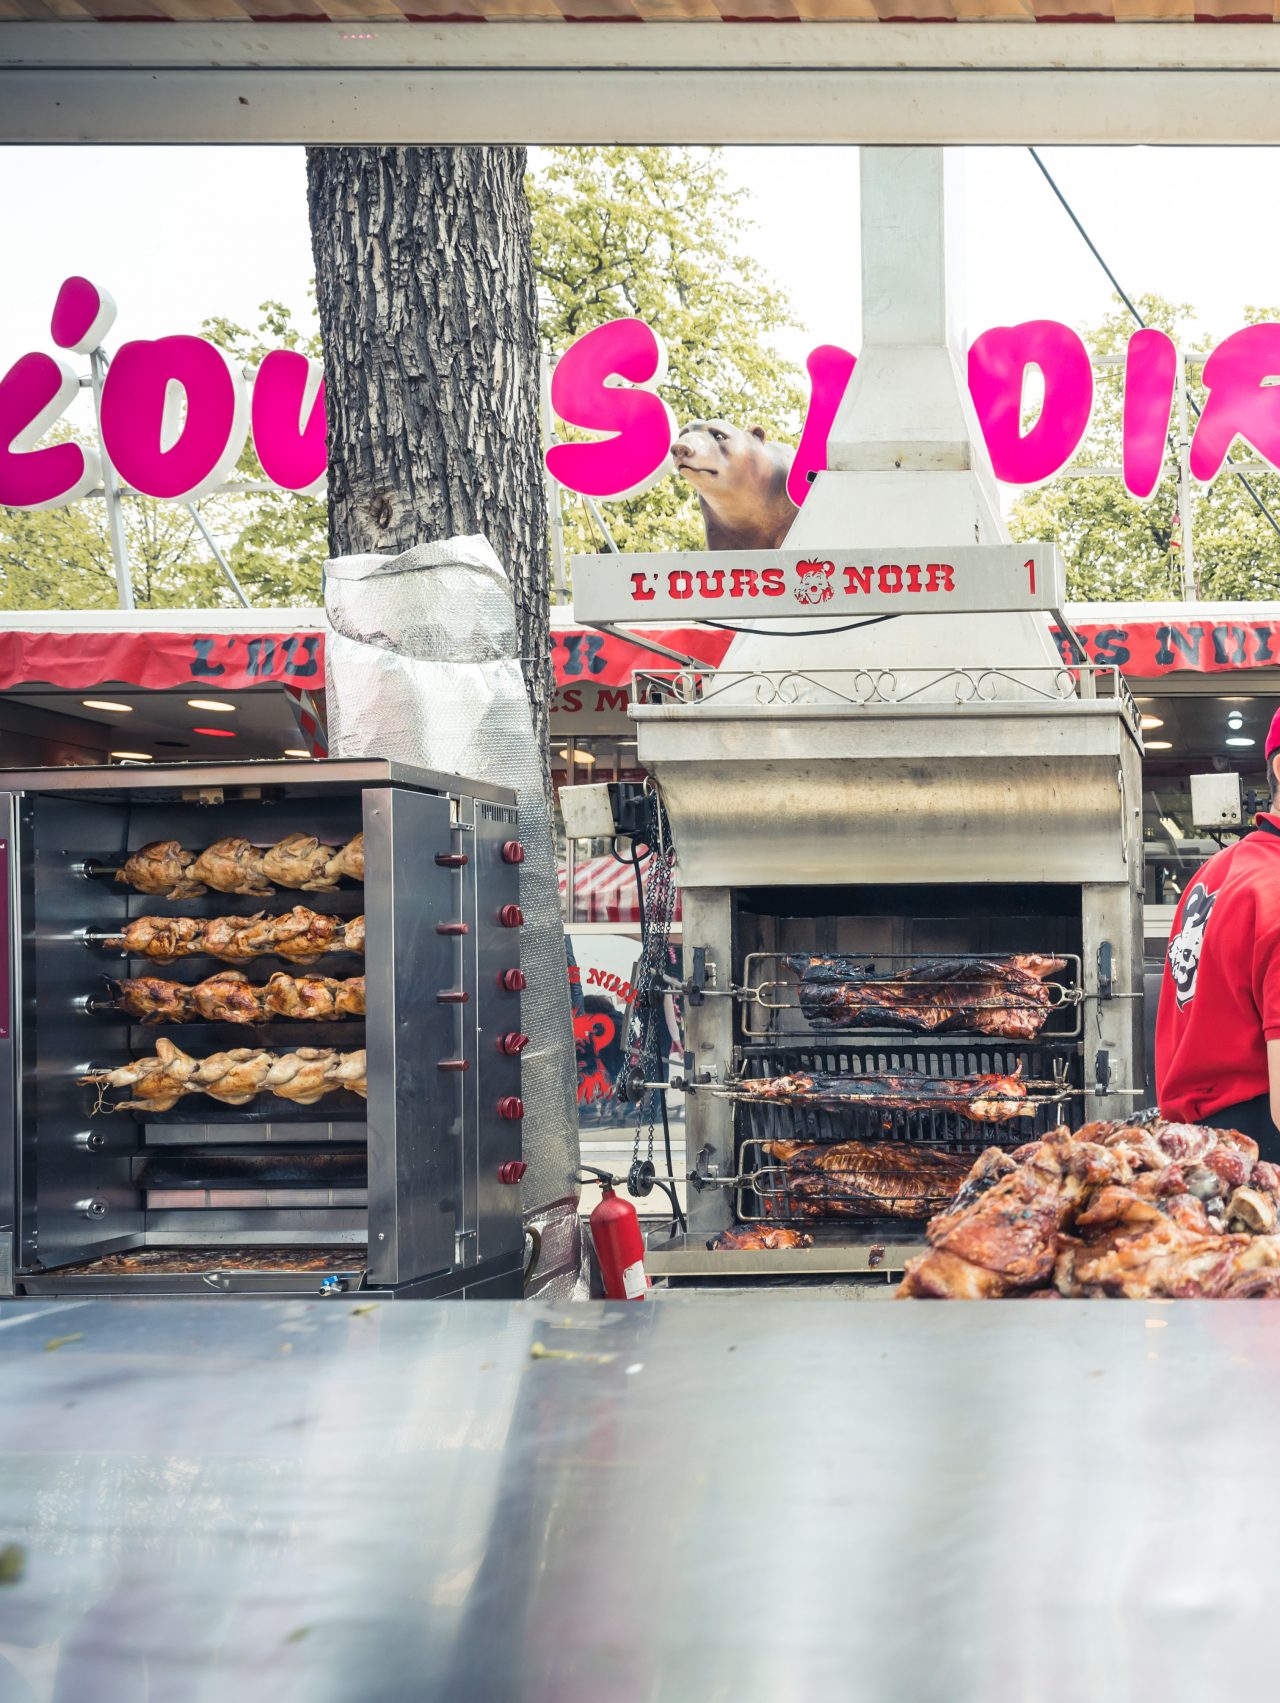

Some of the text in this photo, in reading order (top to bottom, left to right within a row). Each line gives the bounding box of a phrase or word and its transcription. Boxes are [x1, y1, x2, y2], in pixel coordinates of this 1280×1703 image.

[630, 567, 786, 601] L'OURS
[842, 563, 956, 595] NOIR
[1023, 559, 1036, 595] 1
